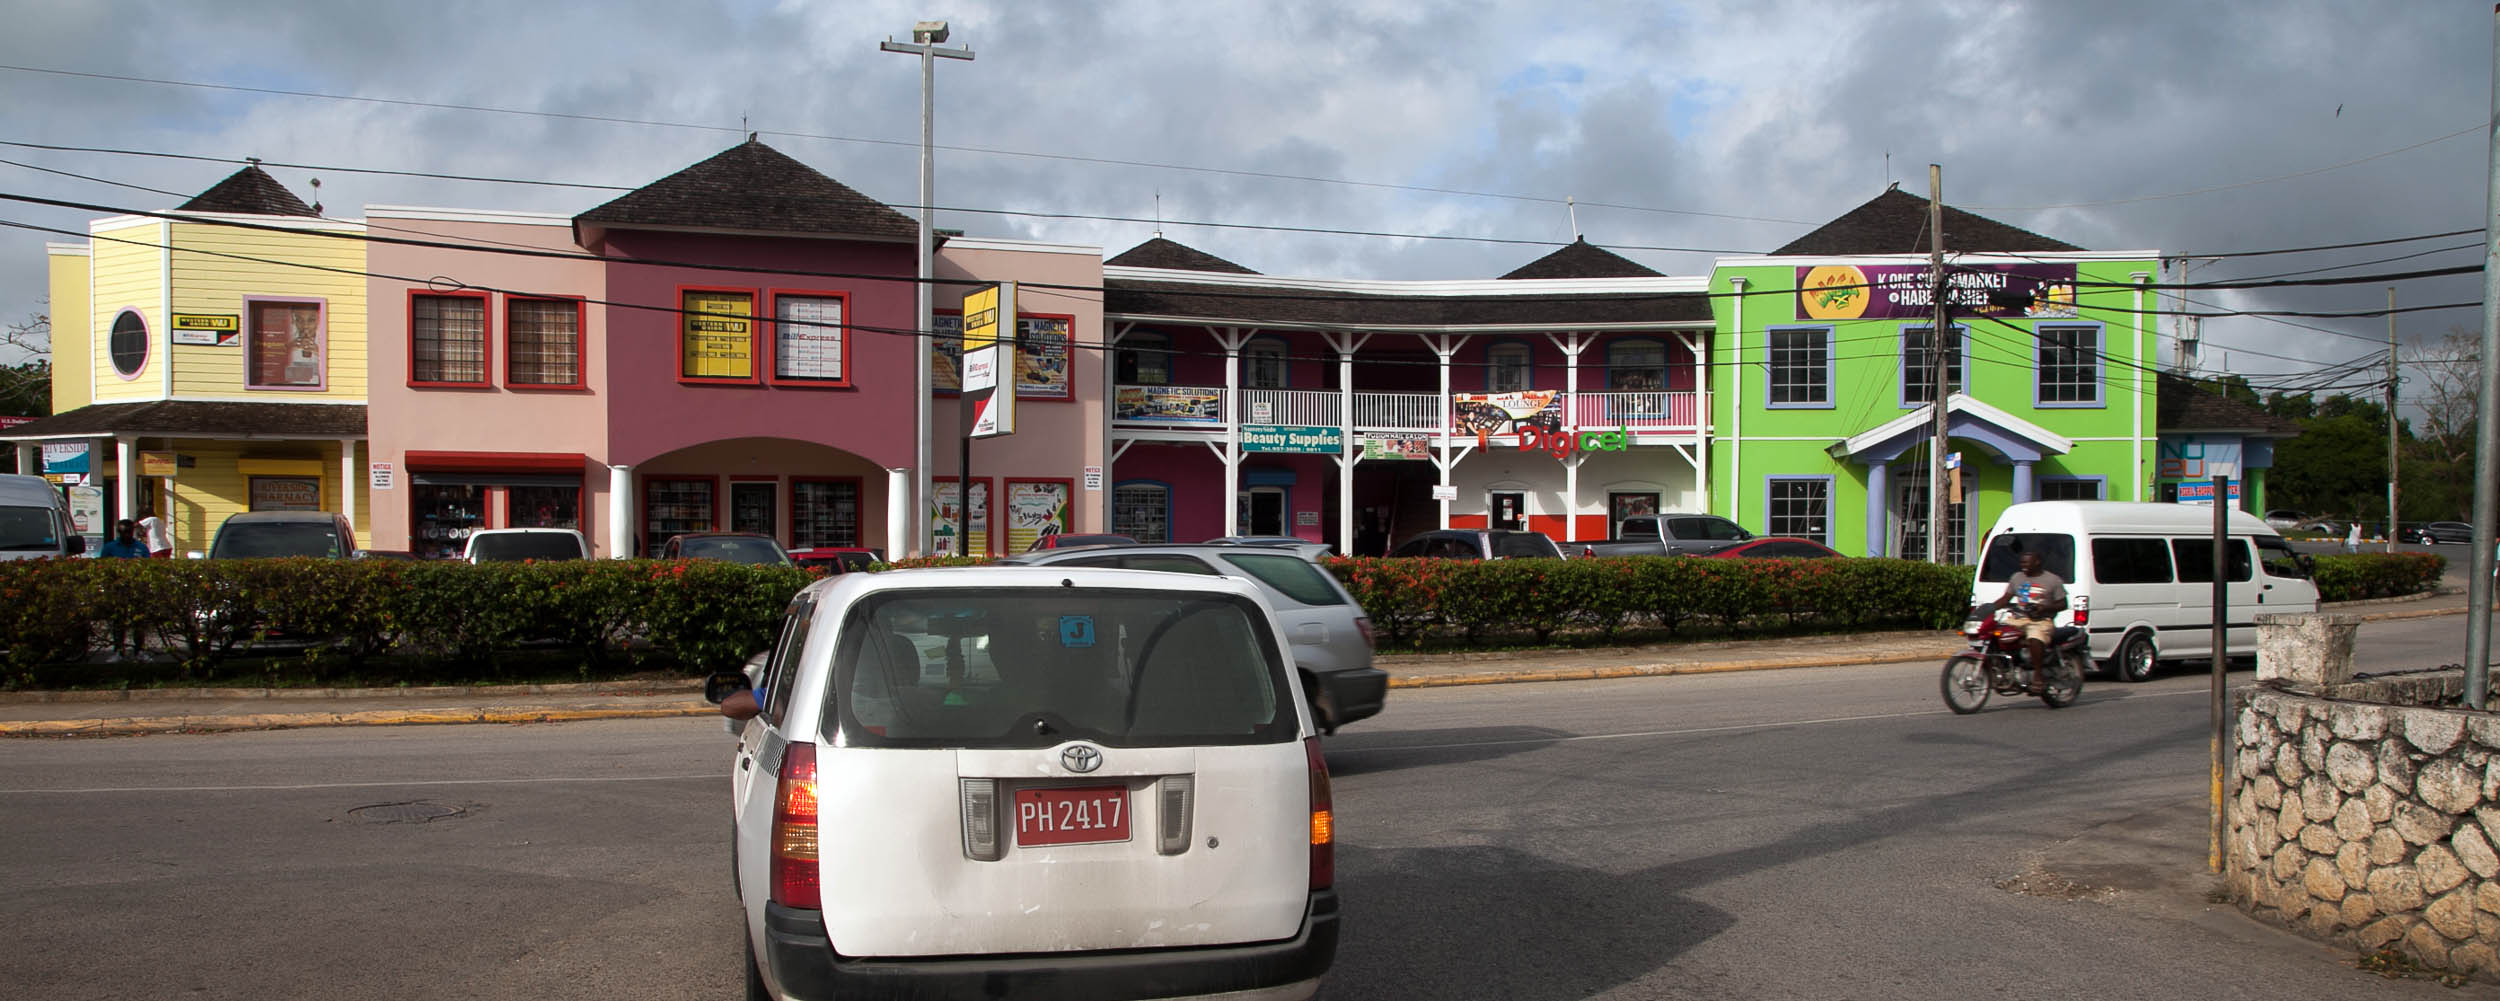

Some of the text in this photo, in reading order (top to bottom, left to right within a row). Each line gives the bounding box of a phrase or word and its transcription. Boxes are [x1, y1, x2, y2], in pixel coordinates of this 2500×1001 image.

[1877, 271, 2009, 289] K ONE SURMARKET
[1146, 386, 1180, 395] MAGNETIC
[1182, 387, 1219, 396] SOLUTIONS
[1502, 399, 1543, 408] LOUNGE
[1243, 430, 1340, 447] Beauty Supplies
[1517, 424, 1627, 459] Digicel
[1070, 623, 1084, 639] J
[1021, 797, 1123, 833] PH 2417
